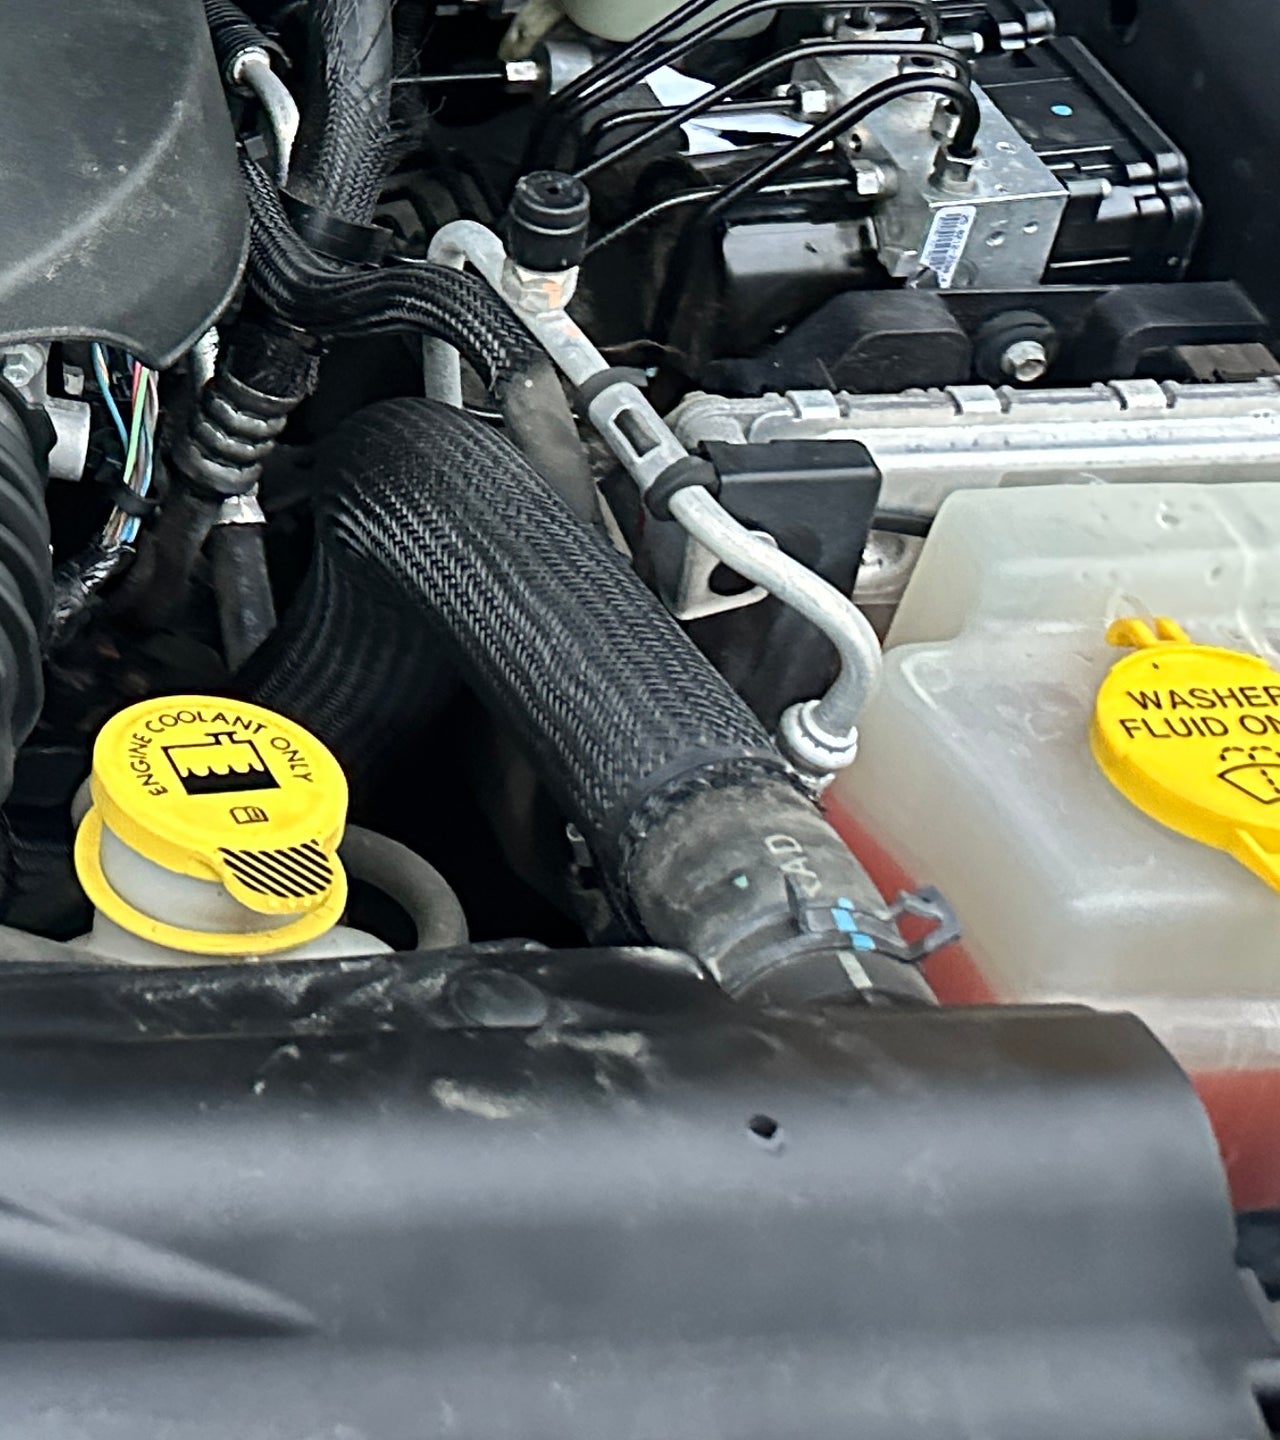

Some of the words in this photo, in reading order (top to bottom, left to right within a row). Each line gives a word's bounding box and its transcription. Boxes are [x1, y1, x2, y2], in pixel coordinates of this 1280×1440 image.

[145, 710, 268, 735] COOLANT
[1119, 716, 1229, 739] FLUID
[128, 733, 168, 796] ENGINE
[270, 736, 314, 783] ONLY
